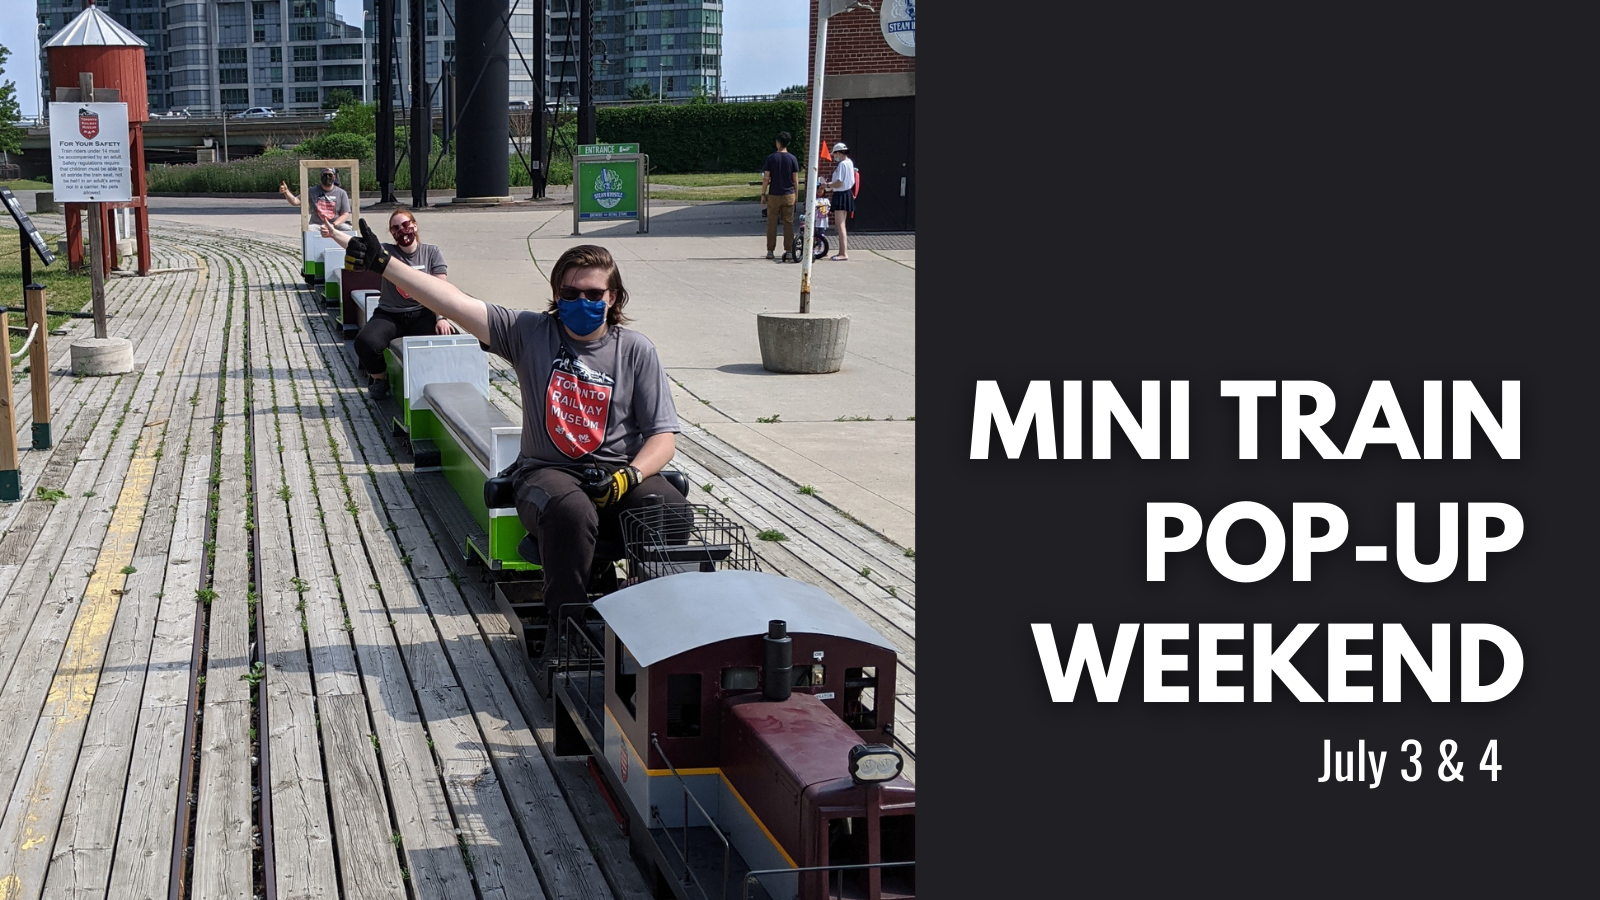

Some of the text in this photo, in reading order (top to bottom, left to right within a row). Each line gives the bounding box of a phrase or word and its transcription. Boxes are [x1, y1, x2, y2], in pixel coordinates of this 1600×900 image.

[890, 22, 910, 31] STEAM
[585, 146, 614, 154] ENTRANCE
[556, 376, 606, 400] TORONTO
[552, 390, 602, 415] RAILWAY
[551, 405, 599, 430] MUSEUM
